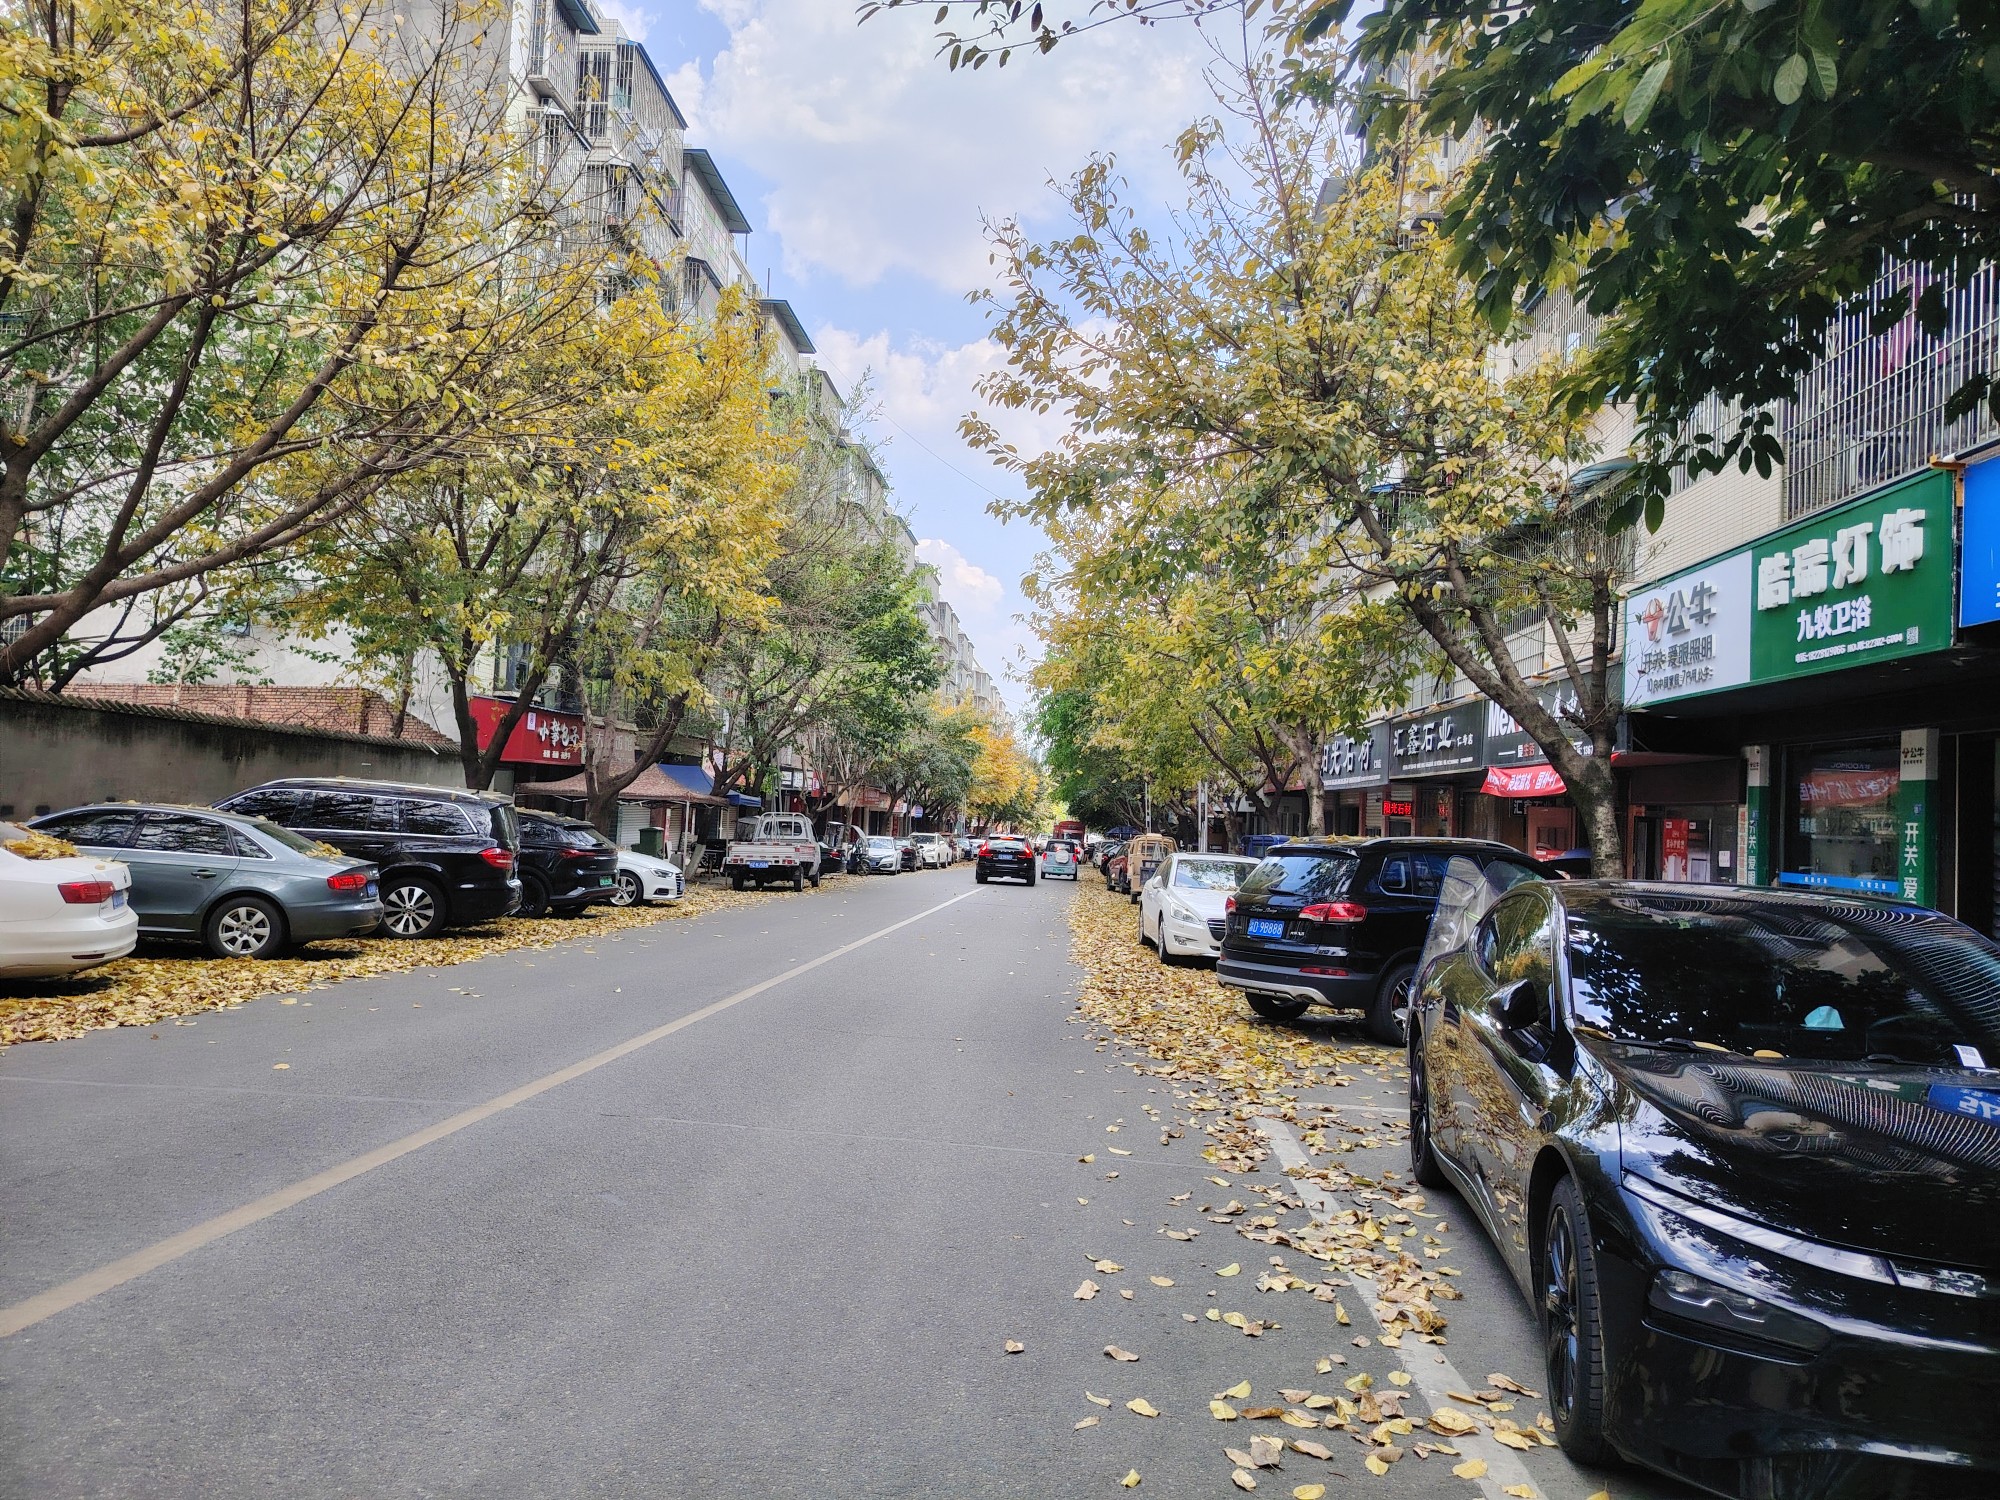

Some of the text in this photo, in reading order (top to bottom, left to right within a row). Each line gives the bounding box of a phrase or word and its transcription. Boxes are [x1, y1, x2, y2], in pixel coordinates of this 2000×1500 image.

[1667, 581, 1717, 635] 公牛
[1797, 595, 1871, 642] 九牧卫浴
[1393, 717, 1454, 756] 汇鑫石业
[1383, 800, 1412, 815] 阳光石材
